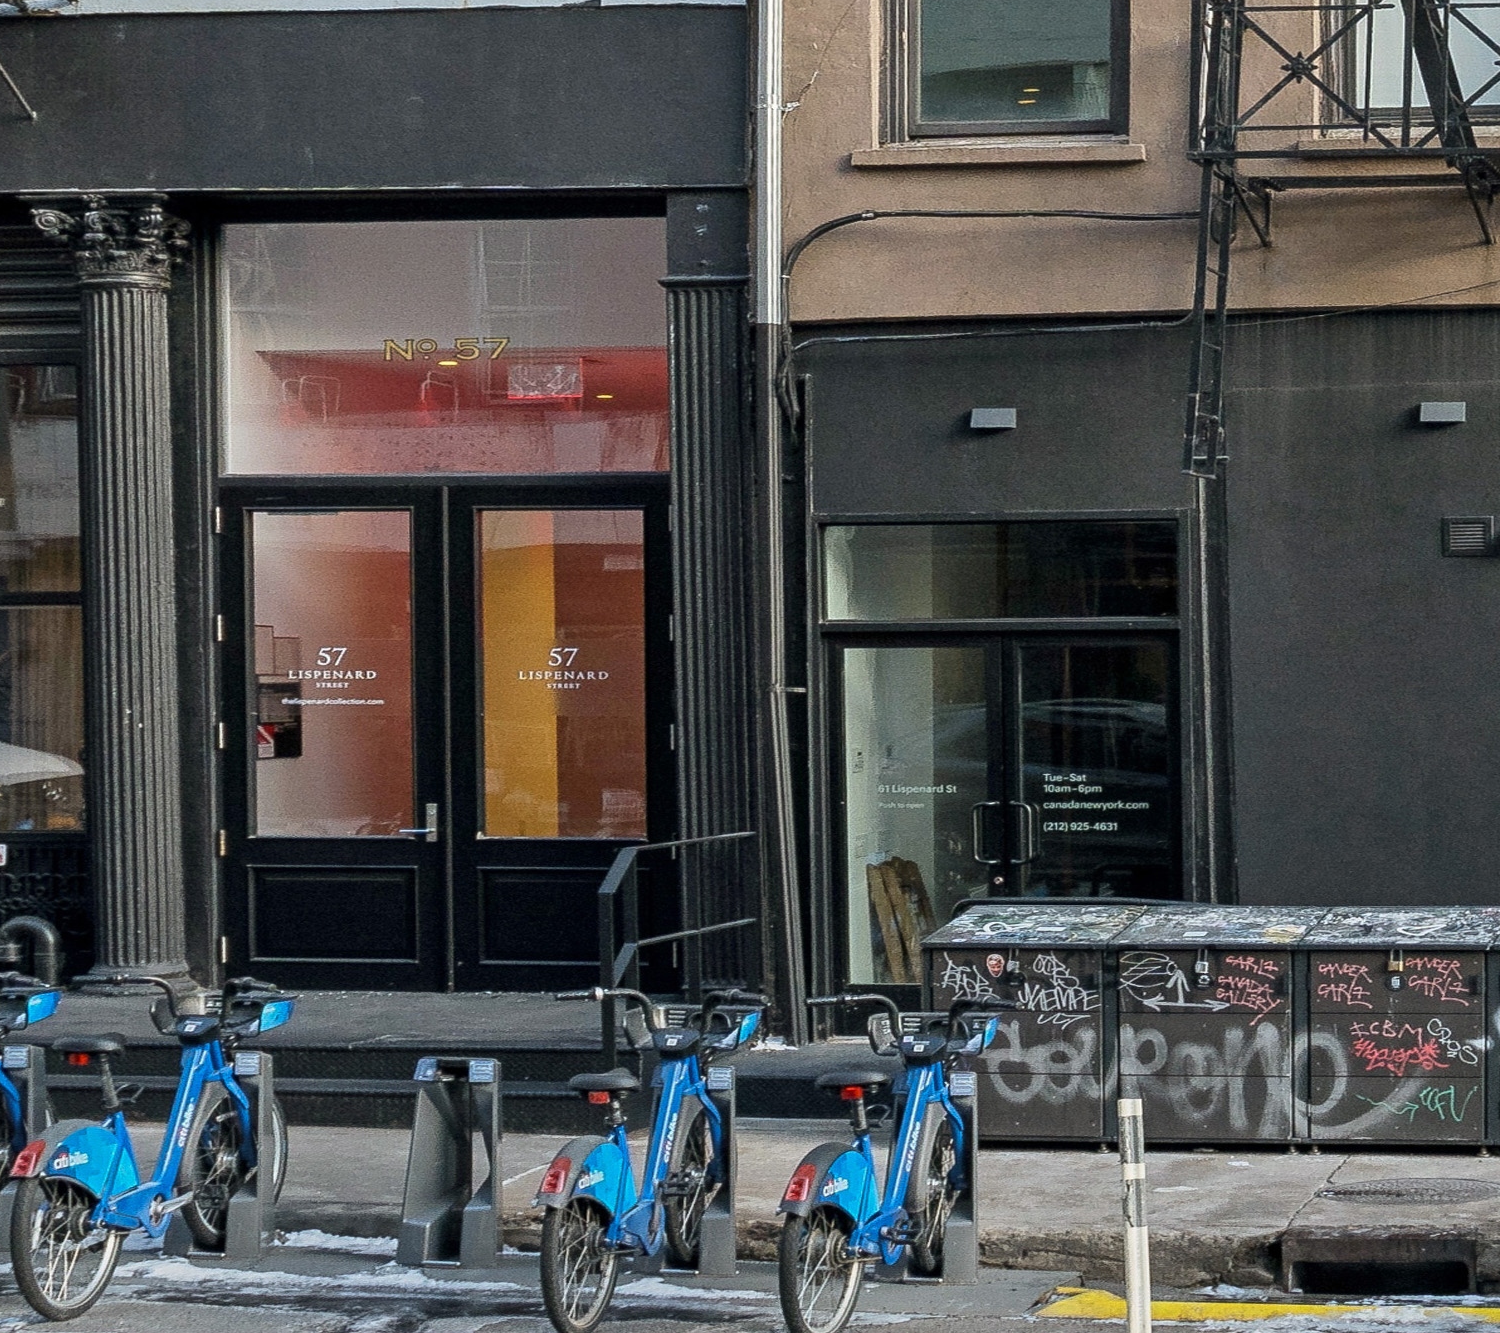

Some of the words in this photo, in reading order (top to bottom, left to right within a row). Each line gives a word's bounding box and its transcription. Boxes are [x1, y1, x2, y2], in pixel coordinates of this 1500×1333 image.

[454, 336, 510, 360] 57
[316, 647, 348, 666] 57
[548, 647, 579, 667] 57
[287, 670, 377, 680] LISPENARD
[518, 670, 609, 680] LISPENARD
[878, 784, 890, 793] 61
[891, 784, 944, 796] Lispenard
[945, 784, 958, 794] St
[1043, 799, 1150, 811] canadanewyork.com
[1043, 821, 1069, 833] (212)
[1070, 822, 1119, 831] 925-4631
[1349, 1019, 1423, 1047] ICBM
[53, 1152, 69, 1171] citi
[68, 1150, 89, 1167] bike
